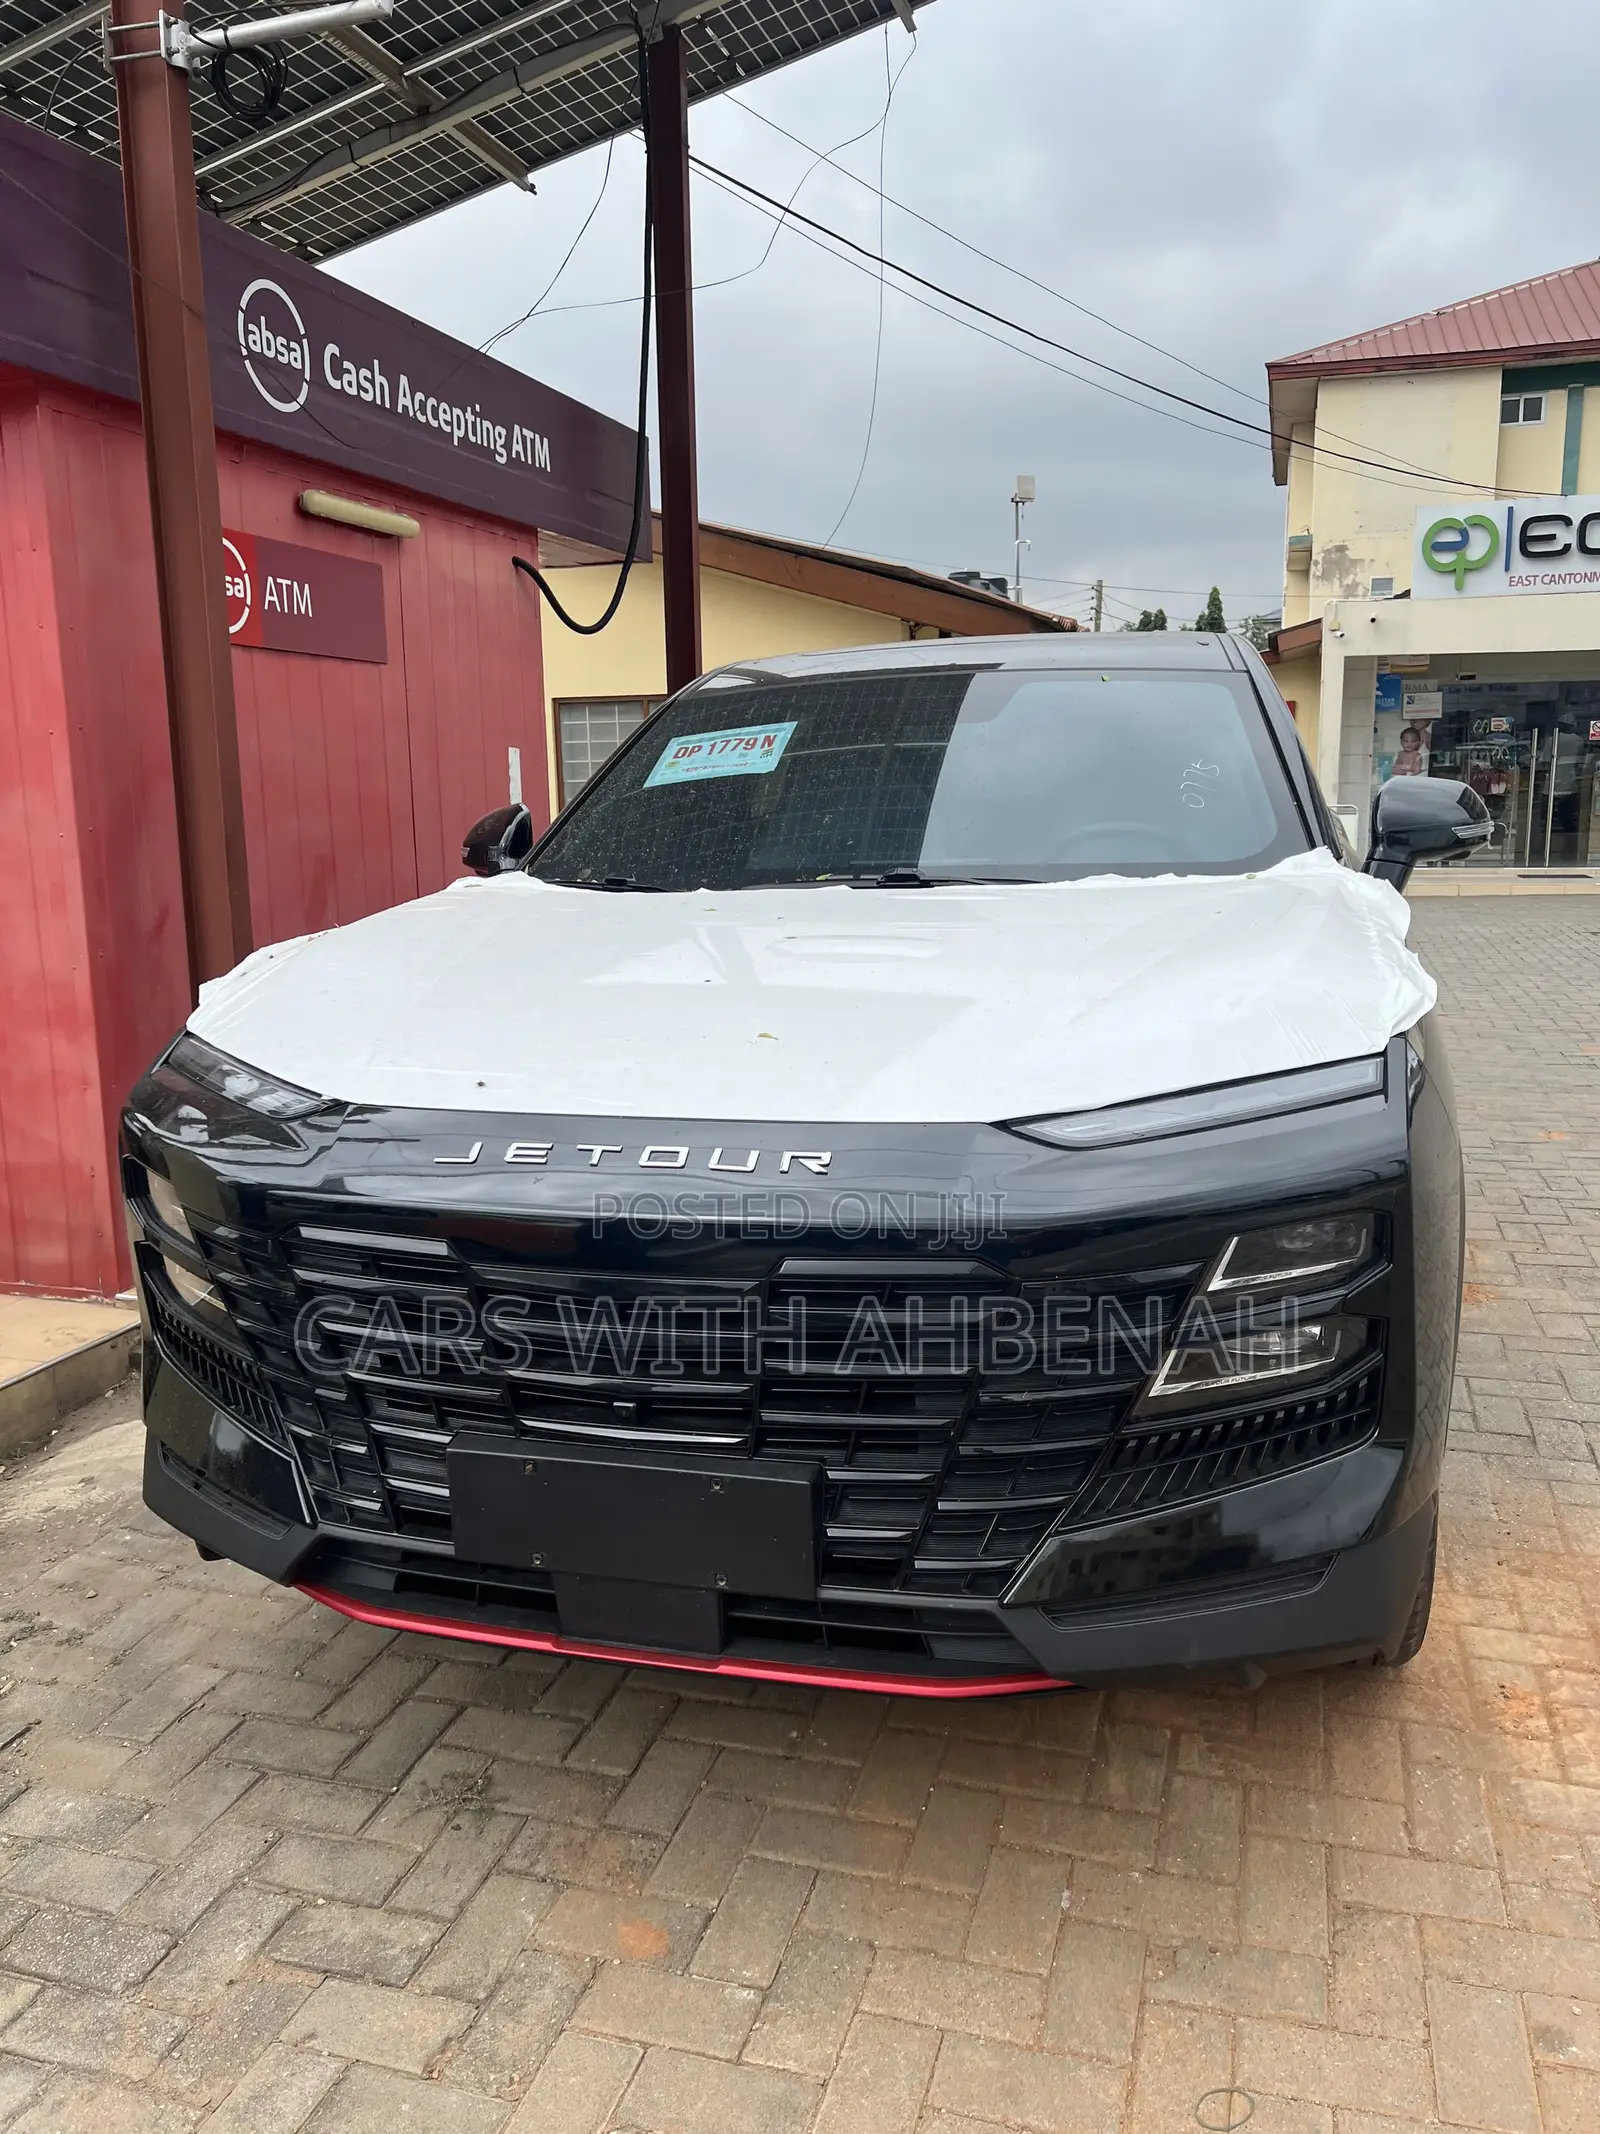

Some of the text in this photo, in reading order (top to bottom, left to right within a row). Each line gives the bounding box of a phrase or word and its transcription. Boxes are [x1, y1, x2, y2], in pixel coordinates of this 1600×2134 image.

[247, 315, 302, 370] absa
[324, 343, 552, 472] Cash Accepting ATM
[264, 576, 313, 618] ATM
[1508, 574, 1540, 587] EAST
[673, 745, 703, 759] DP
[707, 737, 758, 756] 1779
[760, 735, 778, 749] N
[432, 1140, 834, 1175] JETOUR
